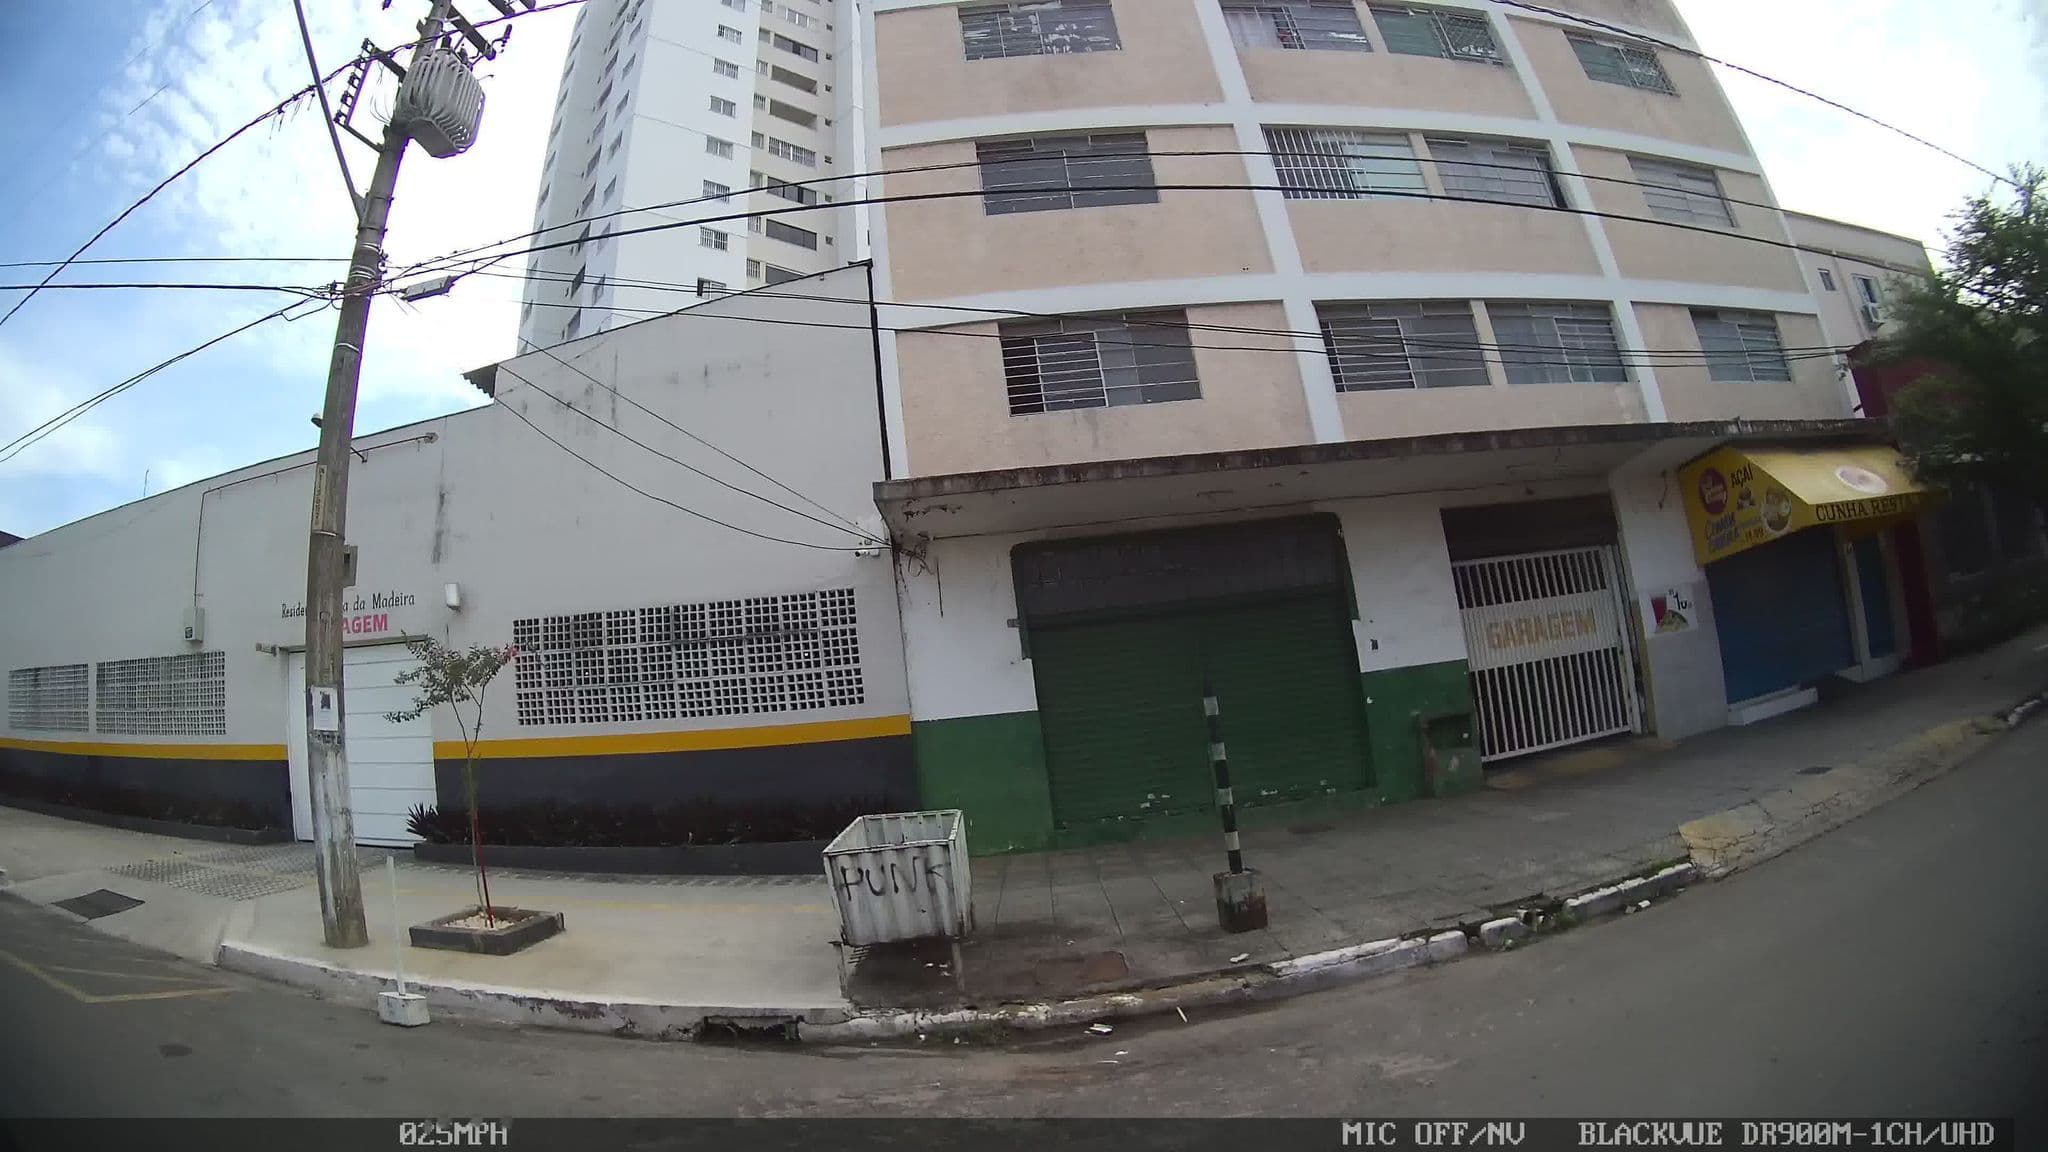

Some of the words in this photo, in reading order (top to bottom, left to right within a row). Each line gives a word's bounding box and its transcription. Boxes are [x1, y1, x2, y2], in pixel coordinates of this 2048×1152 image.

[1815, 501, 1868, 522] CUNHA
[353, 595, 366, 612] da
[372, 590, 415, 609] Madeira
[341, 613, 389, 635] AGEM
[1486, 609, 1597, 650] GARAGEM
